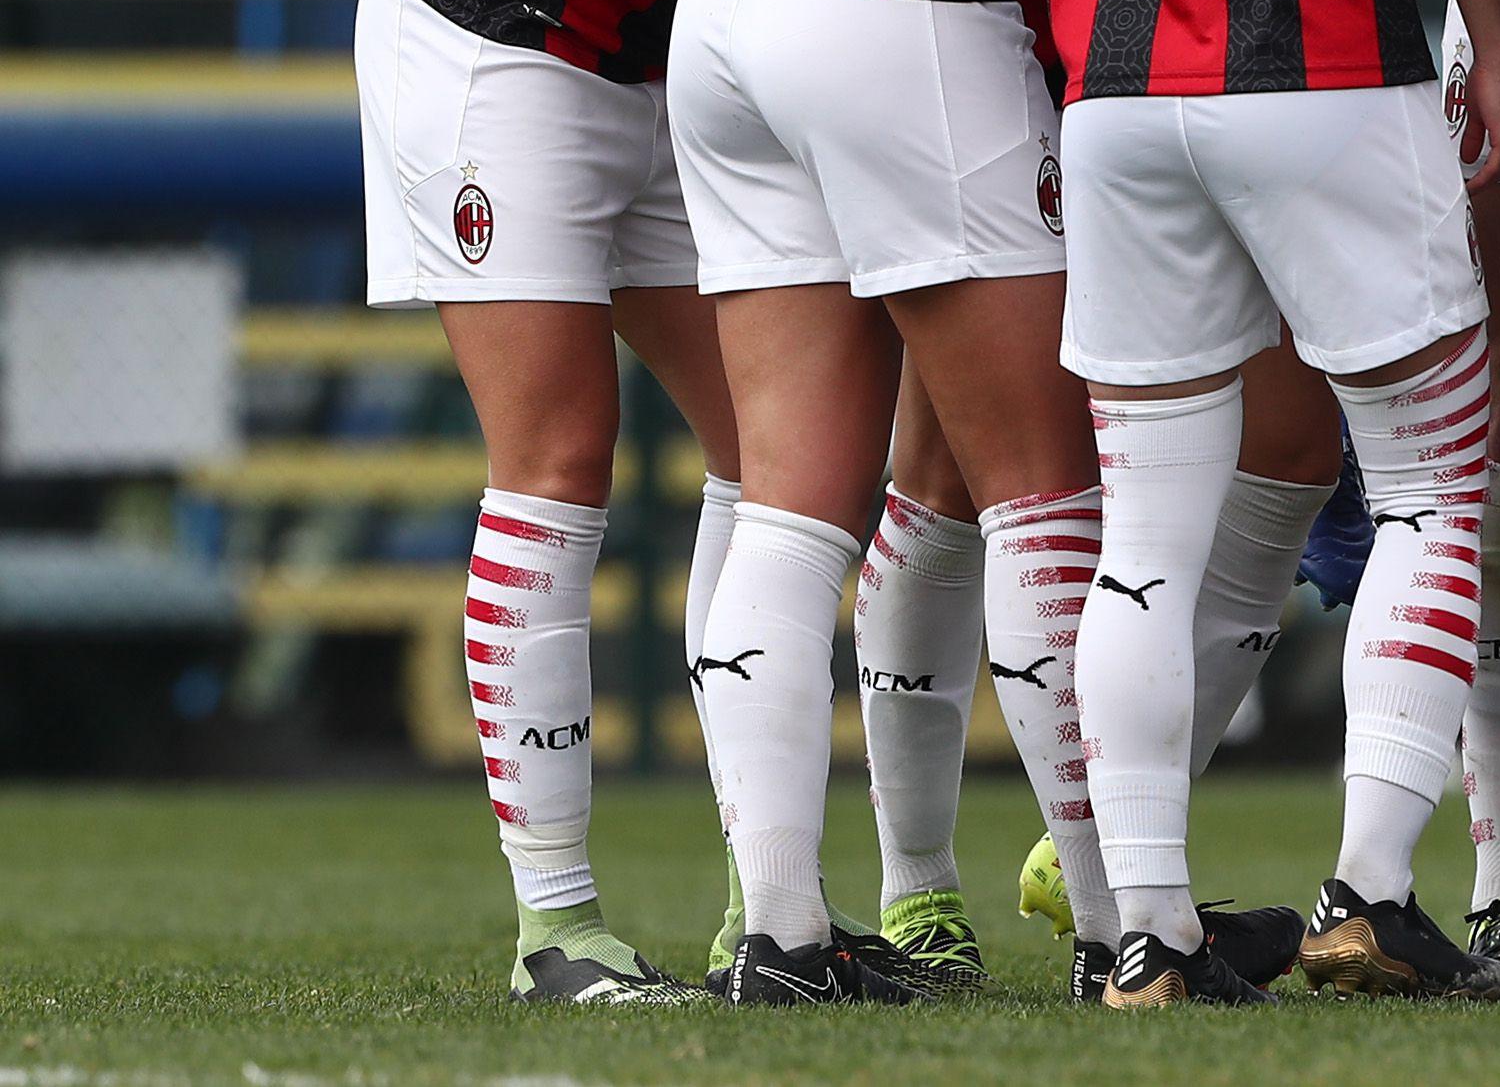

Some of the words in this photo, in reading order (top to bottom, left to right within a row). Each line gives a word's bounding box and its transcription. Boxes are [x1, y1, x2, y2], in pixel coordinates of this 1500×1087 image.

[461, 190, 483, 205] ACM
[861, 665, 936, 692] ACM
[519, 715, 591, 751] ACM
[731, 942, 749, 1003] TIEMPO
